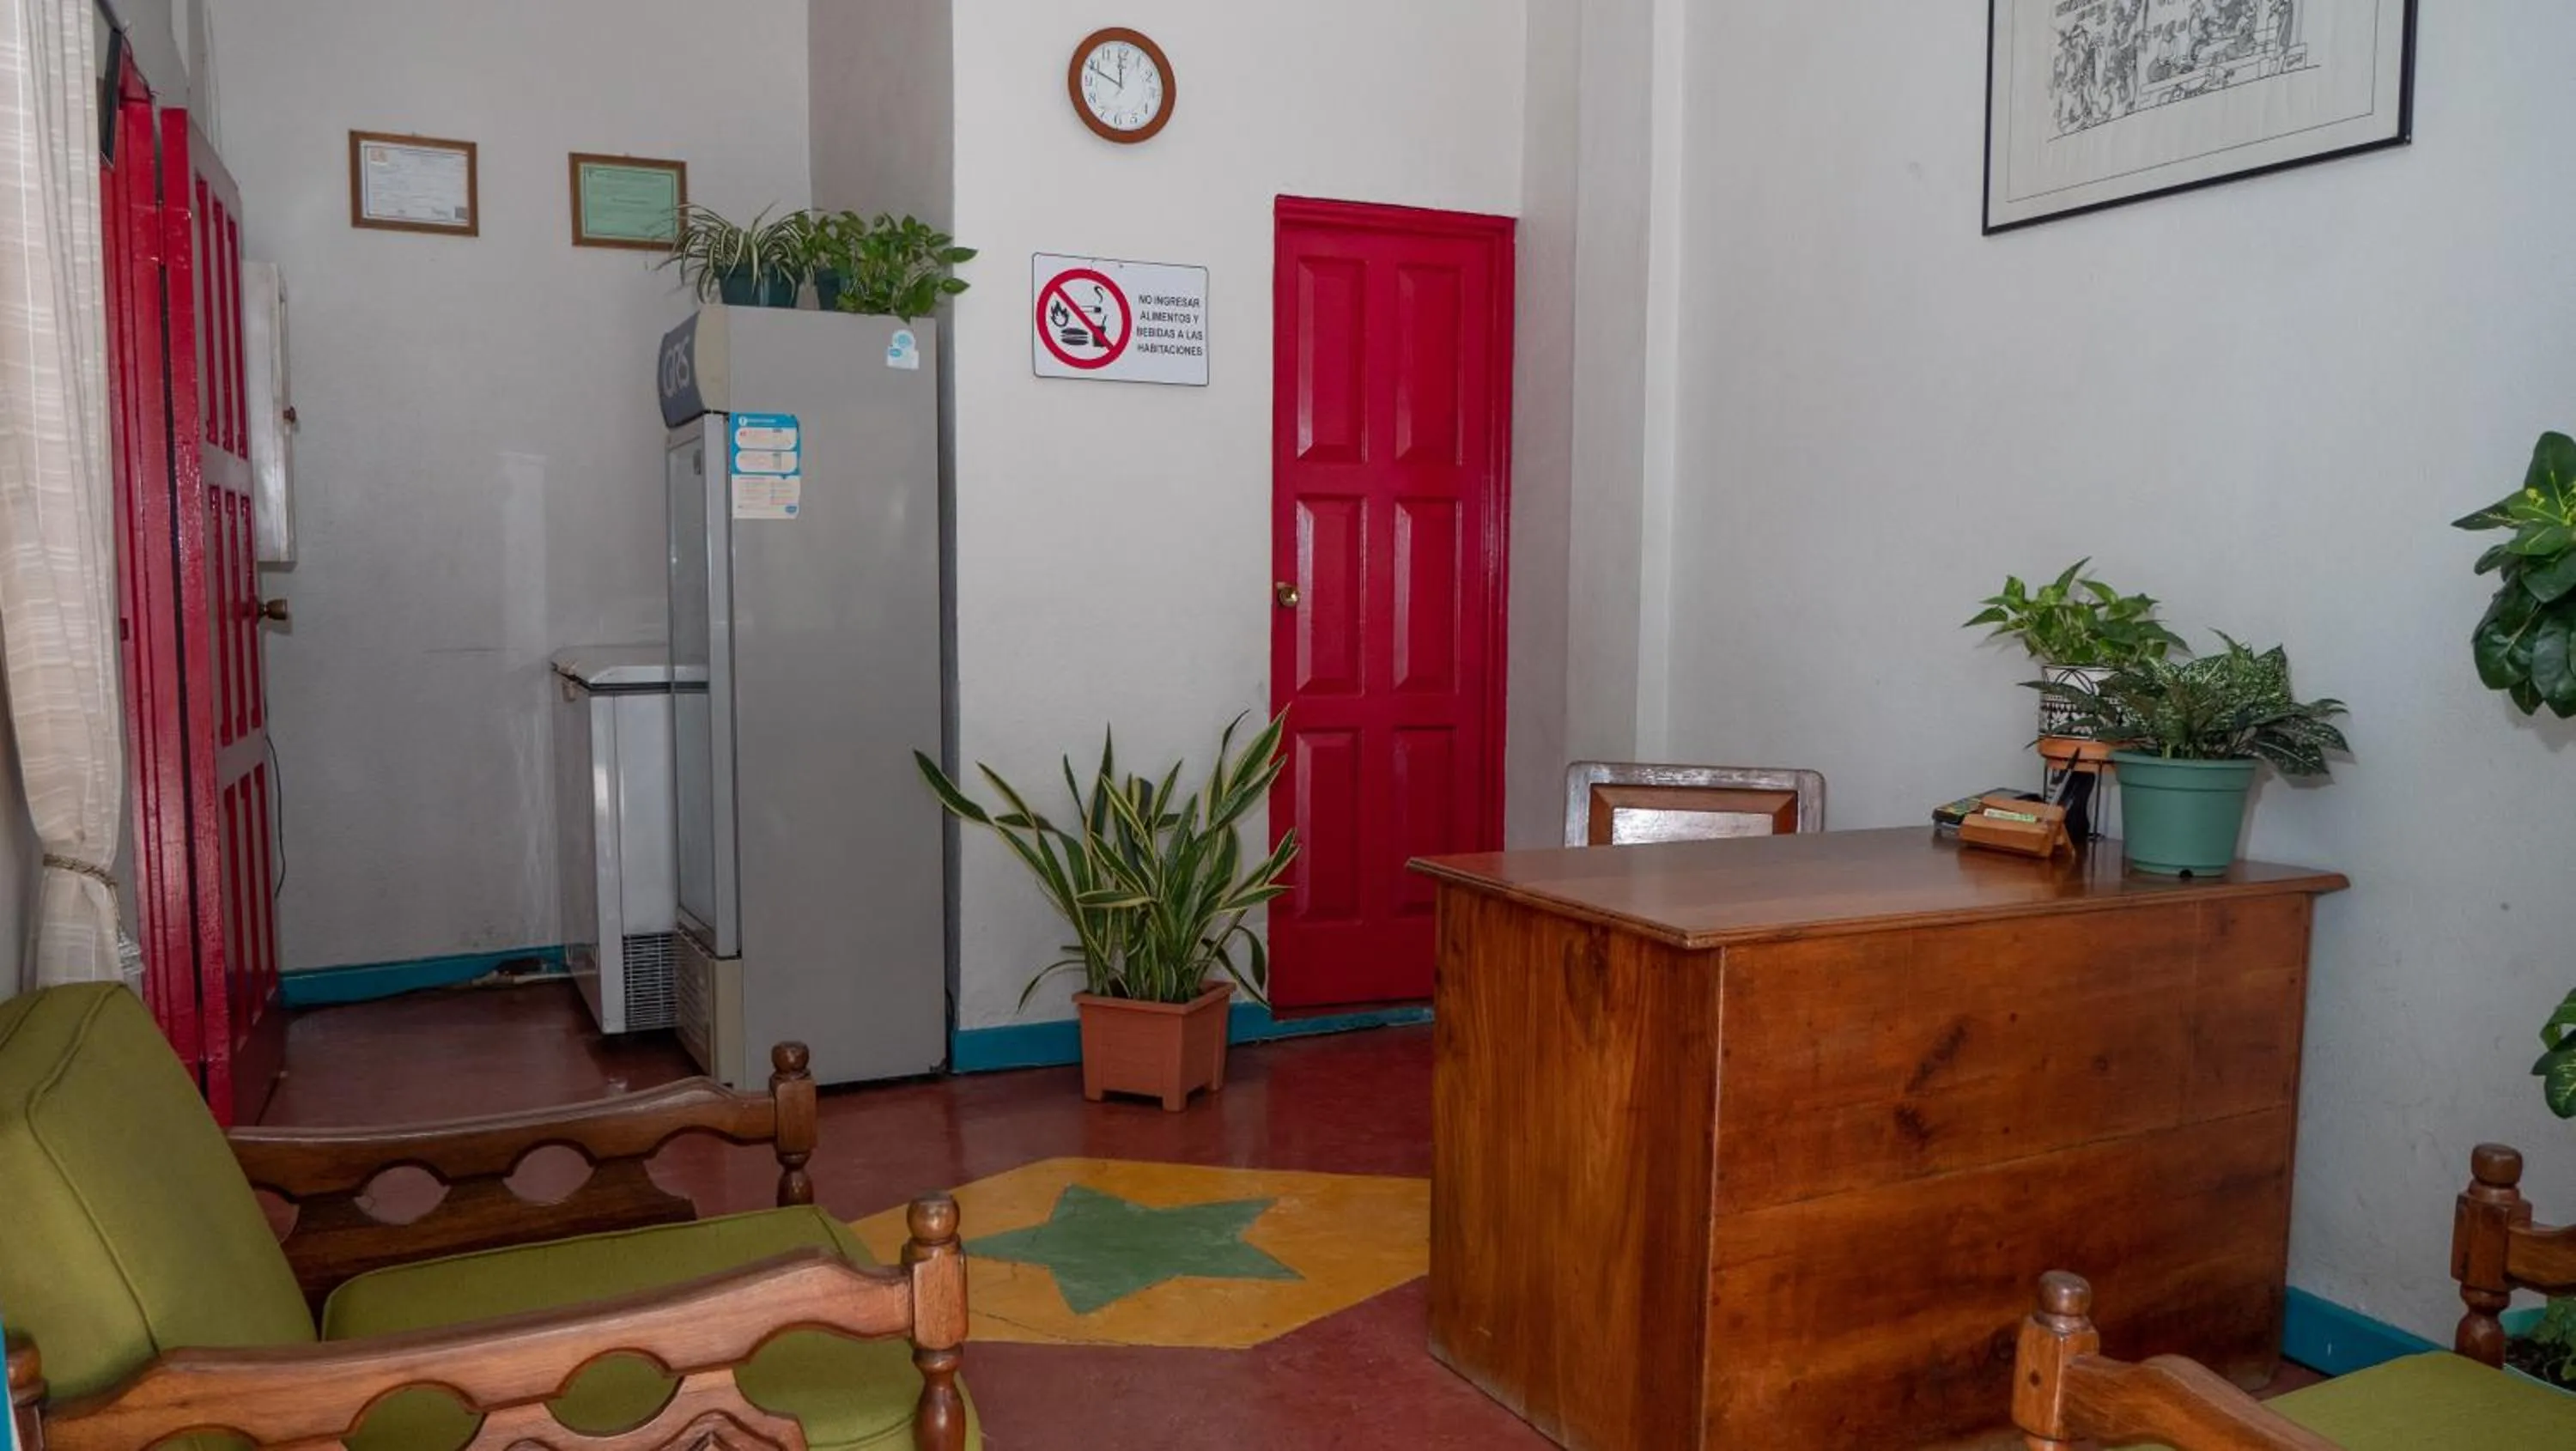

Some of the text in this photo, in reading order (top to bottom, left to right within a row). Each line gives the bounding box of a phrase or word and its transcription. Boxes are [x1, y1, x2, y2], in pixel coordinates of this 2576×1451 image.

[1139, 294, 1200, 308] NO INGRESAR
[1139, 310, 1200, 325] ALIMENTOS Y
[1136, 326, 1203, 341] BEBIDAS A LAS
[1136, 343, 1203, 356] HABITACIONES
